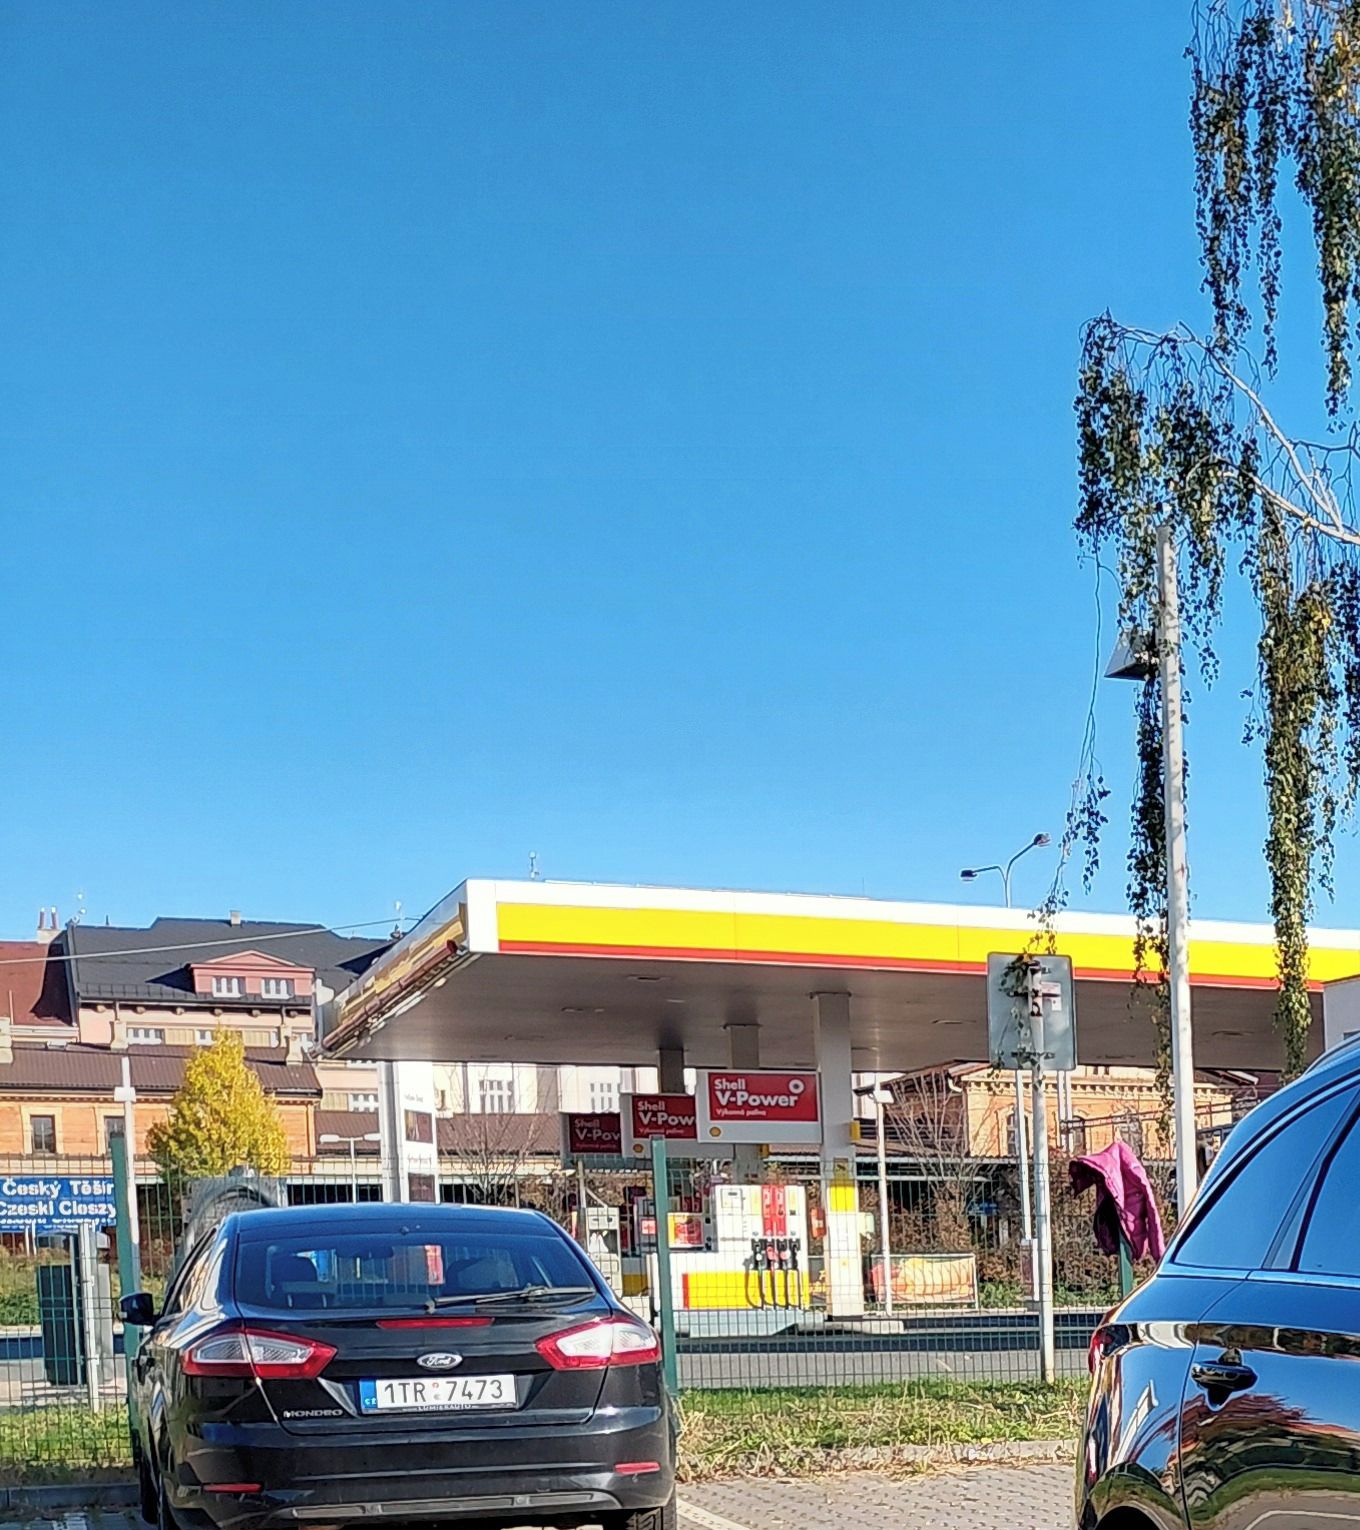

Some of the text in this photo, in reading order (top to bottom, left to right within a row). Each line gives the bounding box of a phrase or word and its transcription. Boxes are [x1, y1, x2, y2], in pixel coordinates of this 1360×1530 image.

[714, 1078, 746, 1090] Shell
[715, 1090, 798, 1107] V-Power
[637, 1101, 666, 1112] Shell
[574, 1118, 600, 1129] Shell
[2, 1178, 61, 1199] Český
[384, 1379, 503, 1405] 1TR 7473
[283, 1408, 343, 1418] MONDEO
